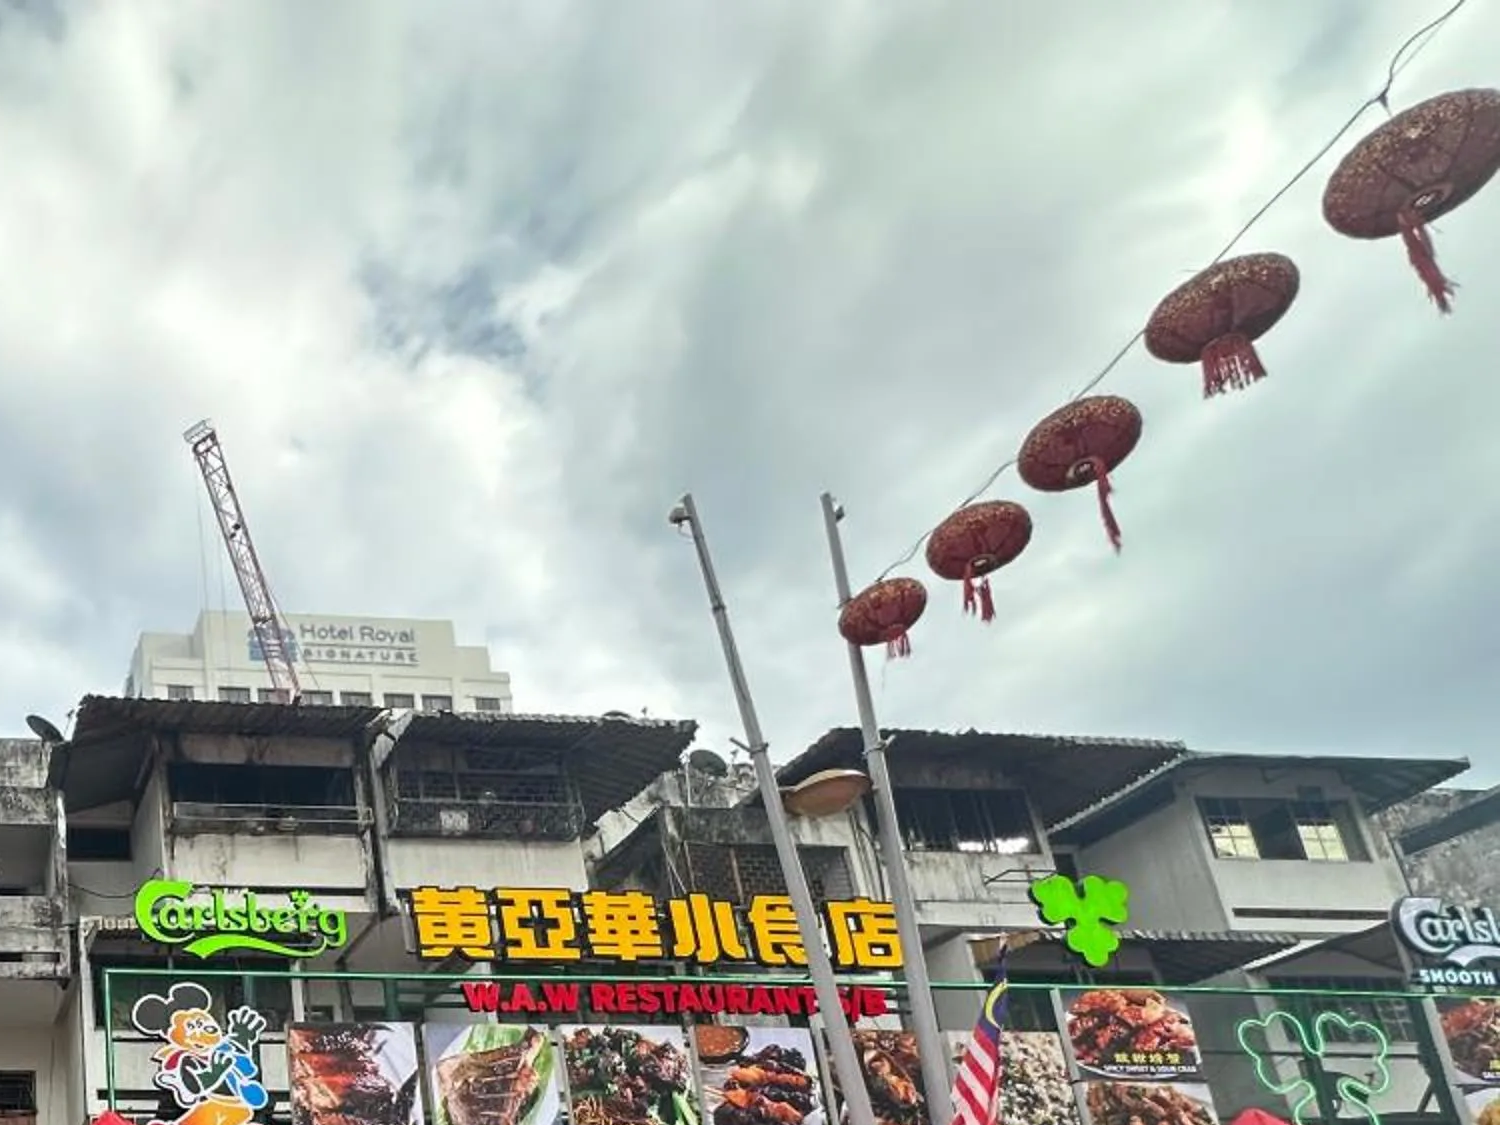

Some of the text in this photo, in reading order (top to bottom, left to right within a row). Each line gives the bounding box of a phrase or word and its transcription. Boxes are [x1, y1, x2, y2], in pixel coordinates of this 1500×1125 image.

[299, 624, 415, 643] Hotel Royal
[135, 880, 348, 952] Carlsberg
[1419, 968, 1496, 986] SMOOTH
[463, 982, 580, 1014] W.A.W
[591, 983, 818, 1016] RESTAURANT
